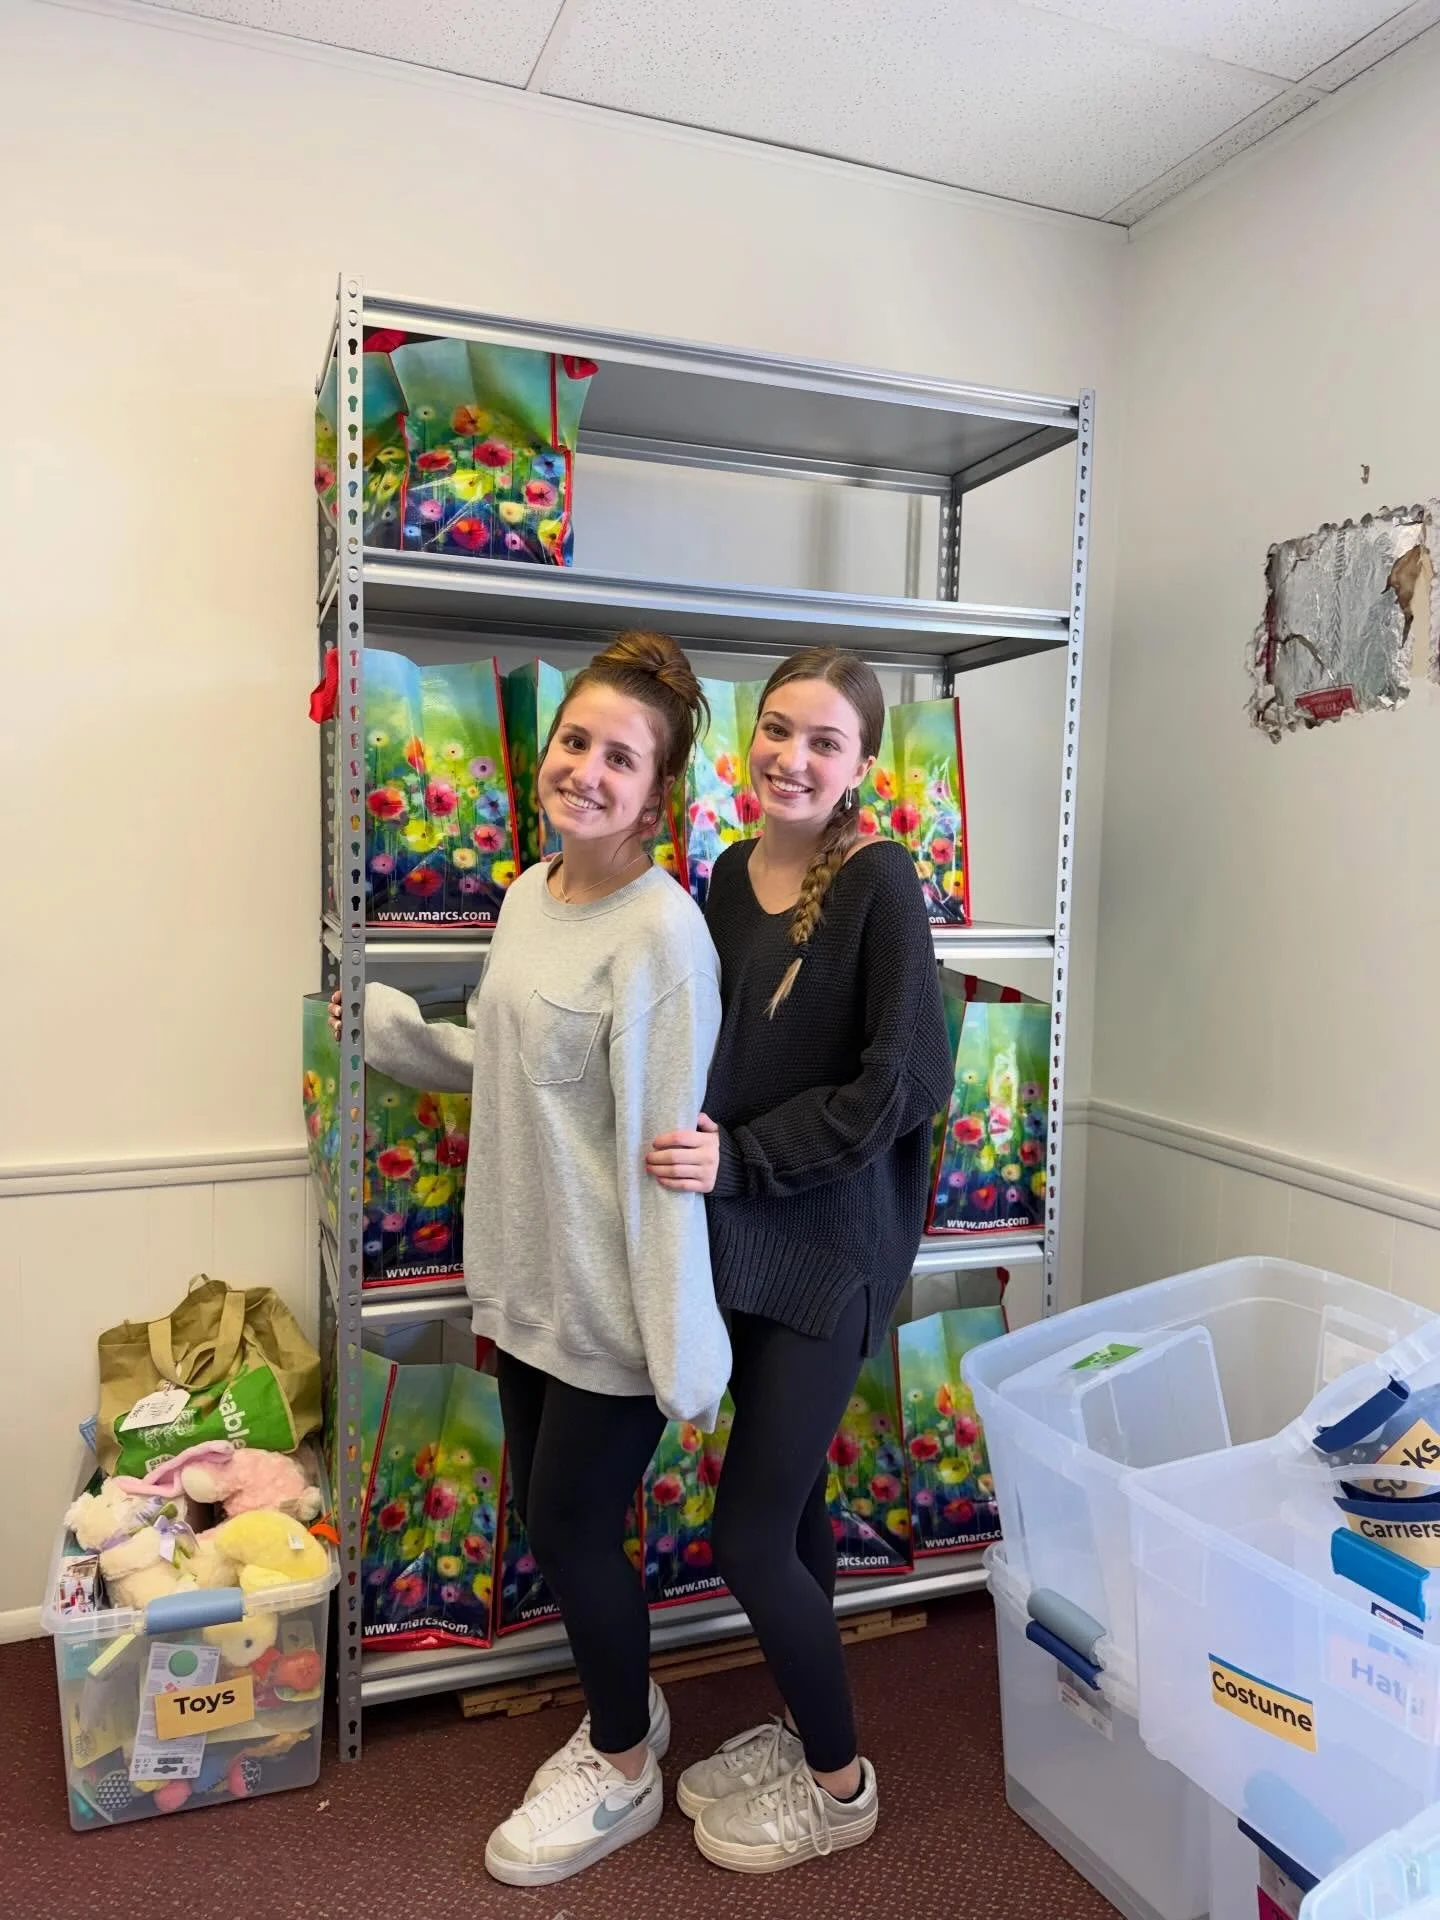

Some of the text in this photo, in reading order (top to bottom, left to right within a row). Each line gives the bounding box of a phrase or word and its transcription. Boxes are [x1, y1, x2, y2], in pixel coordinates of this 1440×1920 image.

[377, 910, 491, 921] www.marcs.com
[946, 1217, 1029, 1229] www.marcs.com
[1359, 1519, 1440, 1538] Carriers
[364, 1617, 469, 1636] www.marcs.com
[173, 1690, 236, 1715] Toys
[1212, 1671, 1313, 1732] Costume
